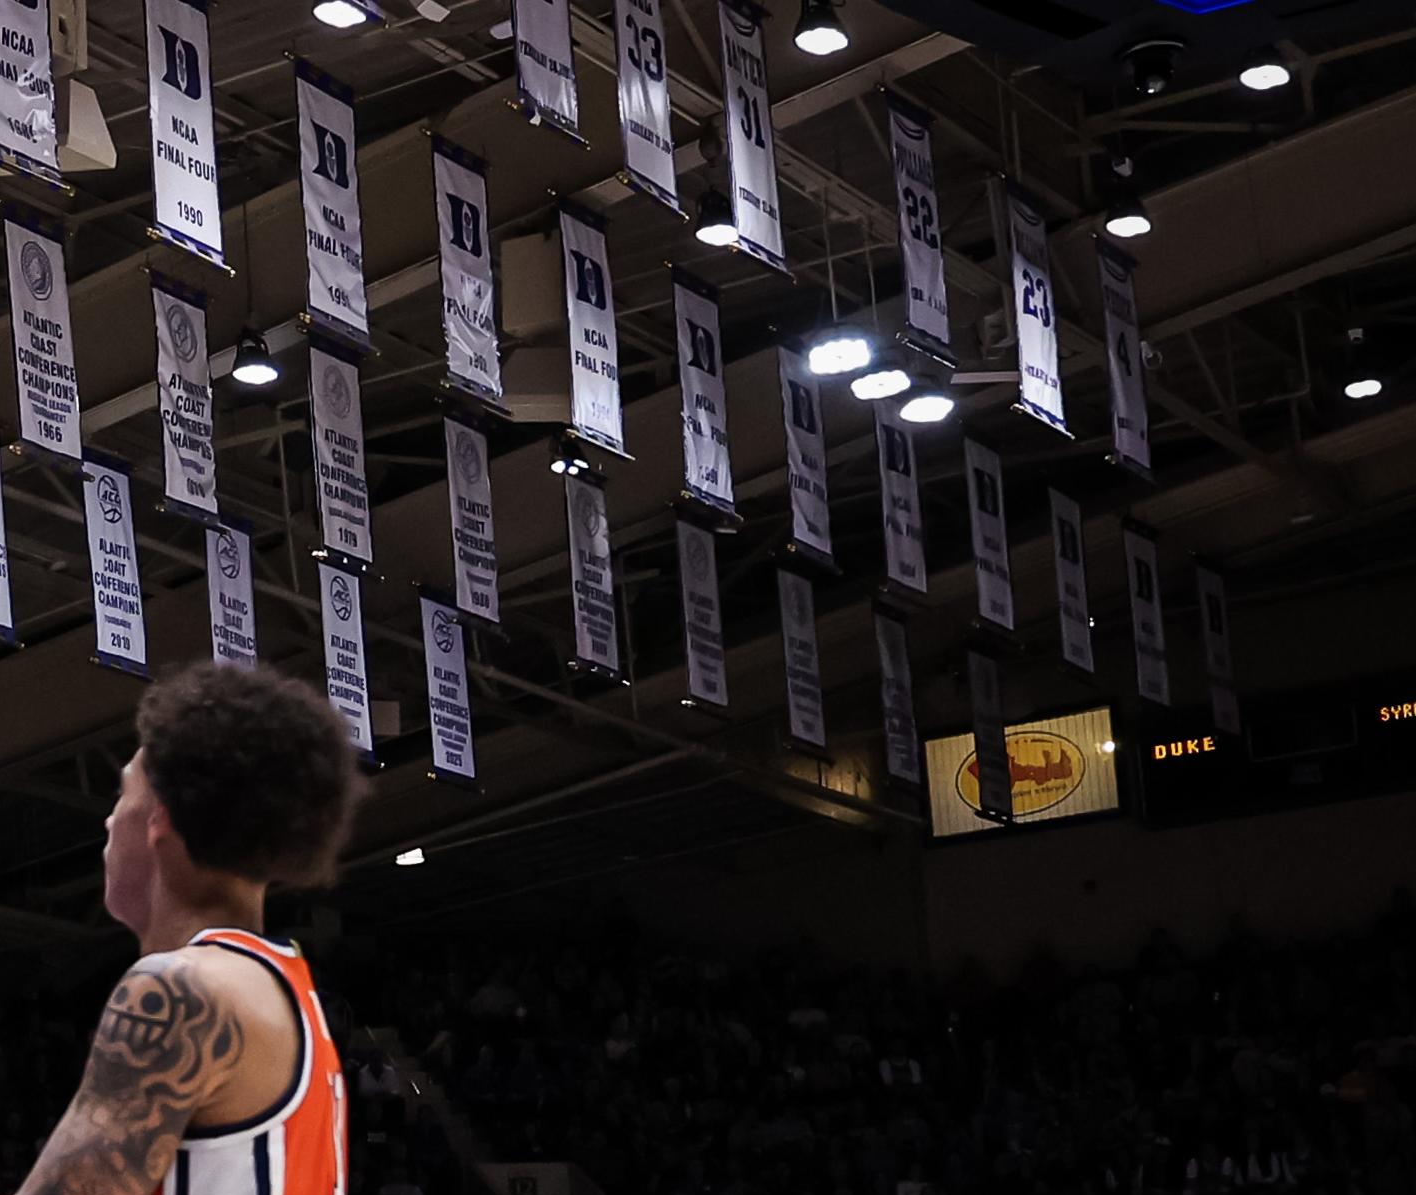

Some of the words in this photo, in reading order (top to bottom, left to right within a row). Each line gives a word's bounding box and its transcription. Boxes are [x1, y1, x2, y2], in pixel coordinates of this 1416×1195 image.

[1, 27, 35, 58] NCAA
[626, 13, 664, 84] 33
[172, 115, 198, 146] NCAA
[737, 85, 766, 150] 31
[157, 140, 186, 171] FINAL
[177, 201, 204, 228] 1990
[322, 204, 346, 232] NCAA
[904, 186, 938, 250] 22
[308, 228, 338, 257] FINAL
[1022, 268, 1051, 328] 23
[23, 310, 63, 339] ATLANTIC
[584, 328, 608, 350] NCAA
[30, 332, 57, 357] COAST
[18, 347, 76, 382] CONFERENCE
[22, 368, 75, 402] CHAMPIONS
[176, 395, 205, 417] COAST
[37, 420, 63, 443] 1966
[1154, 736, 1216, 760] DUKE
